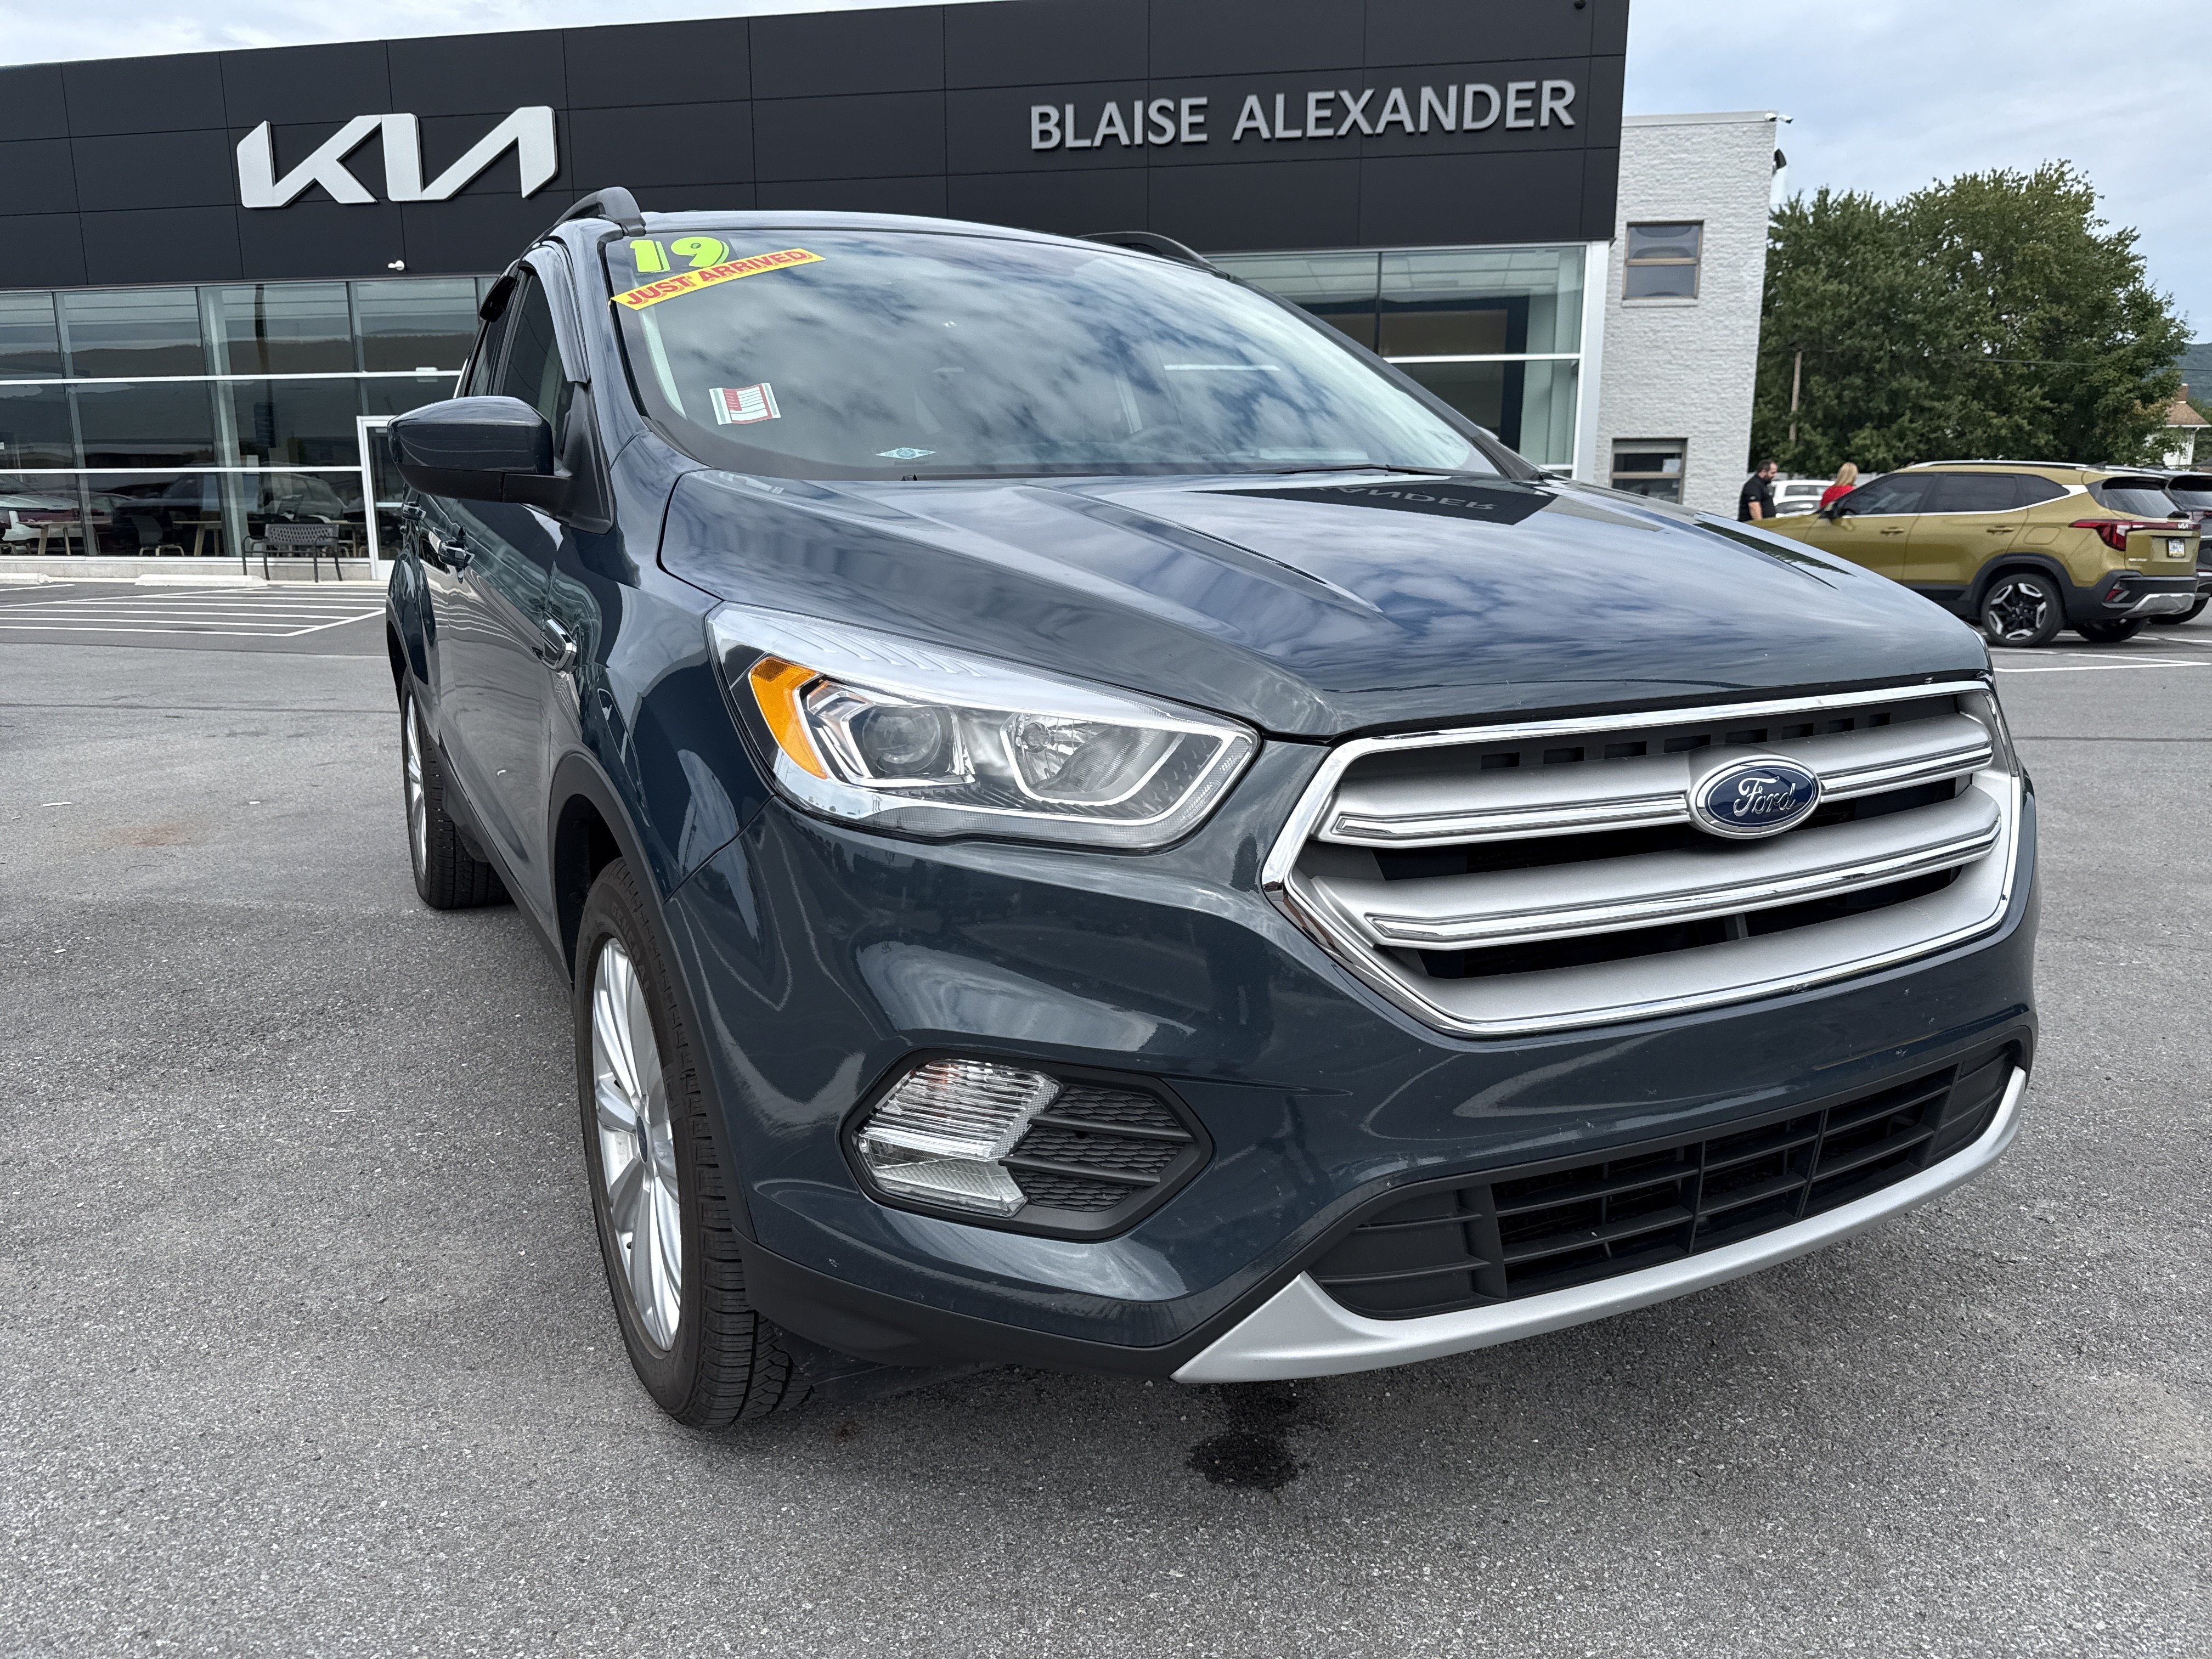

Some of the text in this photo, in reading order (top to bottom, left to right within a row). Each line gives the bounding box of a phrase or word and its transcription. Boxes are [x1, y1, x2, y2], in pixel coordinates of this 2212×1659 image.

[1030, 79, 1577, 150] BLAISE ALEXANDER
[236, 106, 558, 208] KIA
[627, 251, 813, 306] JUST ARRIVED
[629, 236, 730, 273] 19
[1733, 776, 1796, 817] Ford
